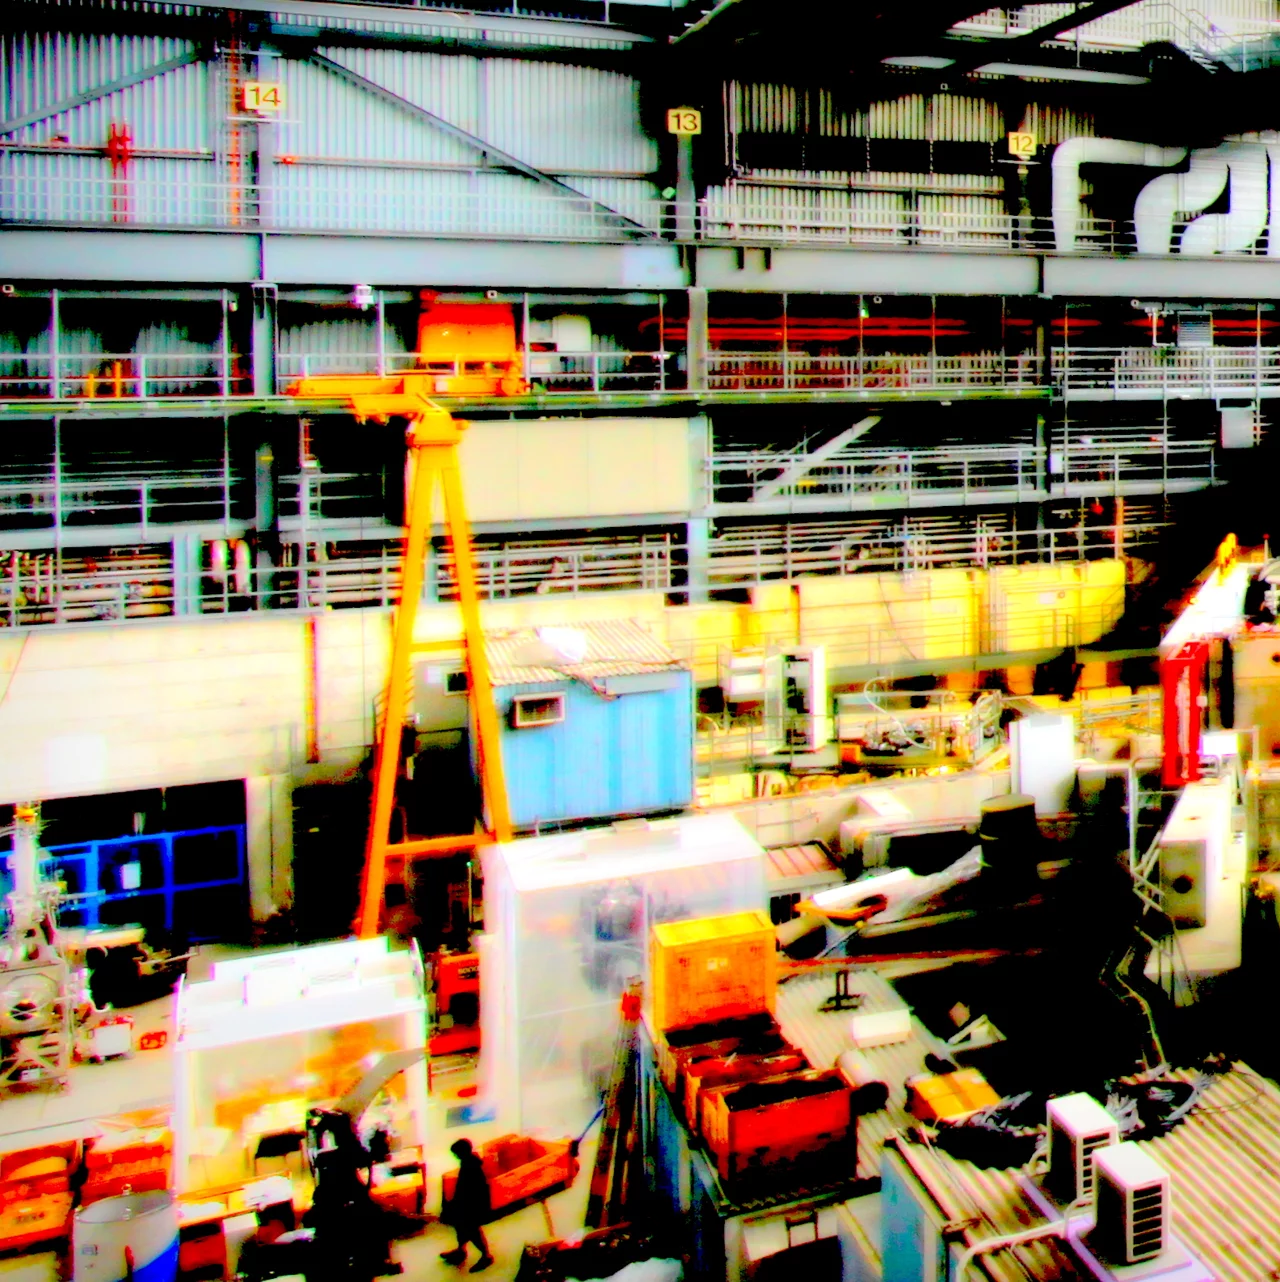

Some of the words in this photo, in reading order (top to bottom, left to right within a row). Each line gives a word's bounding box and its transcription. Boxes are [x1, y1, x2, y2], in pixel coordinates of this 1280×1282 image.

[249, 86, 282, 106] 14
[671, 112, 698, 131] 13
[1011, 135, 1034, 152] 12
